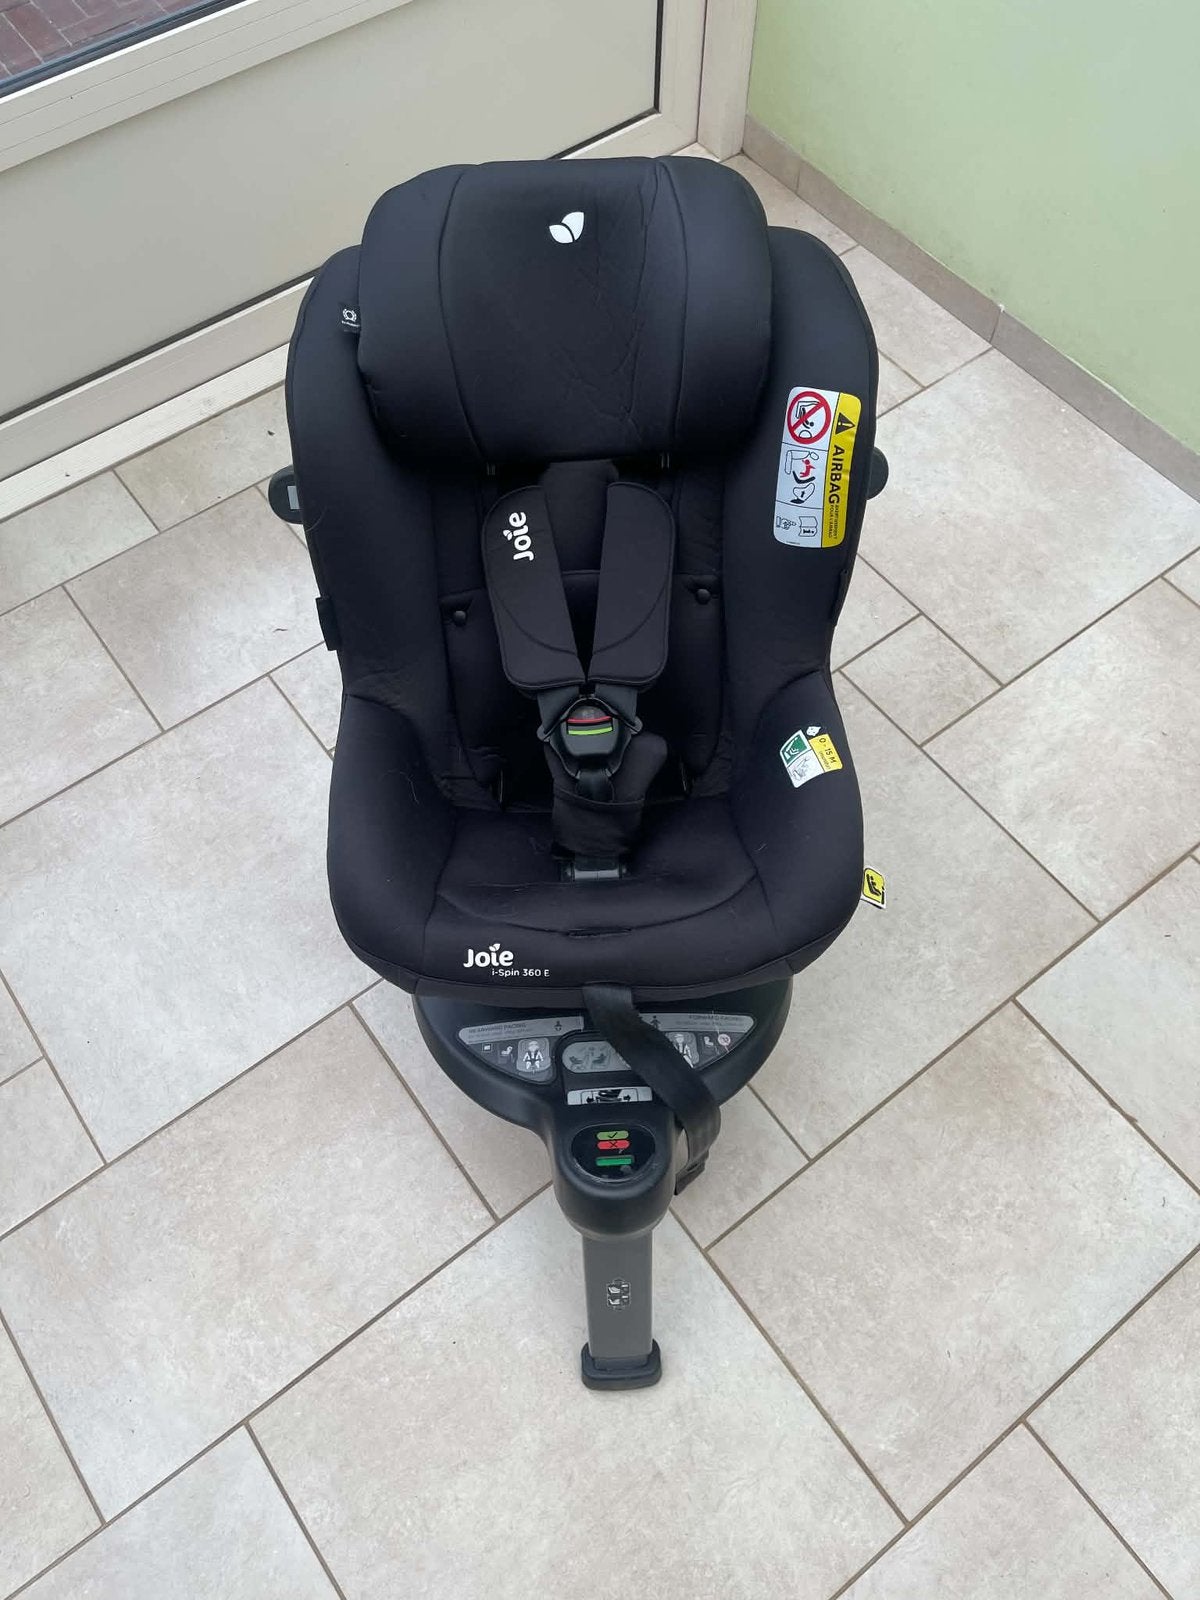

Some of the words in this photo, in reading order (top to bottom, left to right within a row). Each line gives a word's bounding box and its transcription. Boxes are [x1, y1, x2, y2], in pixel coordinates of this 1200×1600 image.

[828, 444, 845, 504] AIRBAG
[502, 512, 534, 561] Joie
[825, 748, 833, 756] 15
[829, 756, 837, 764] M
[462, 943, 514, 968] Joie
[491, 968, 520, 978] i-Spin
[522, 968, 542, 977] 360
[544, 969, 550, 977] E
